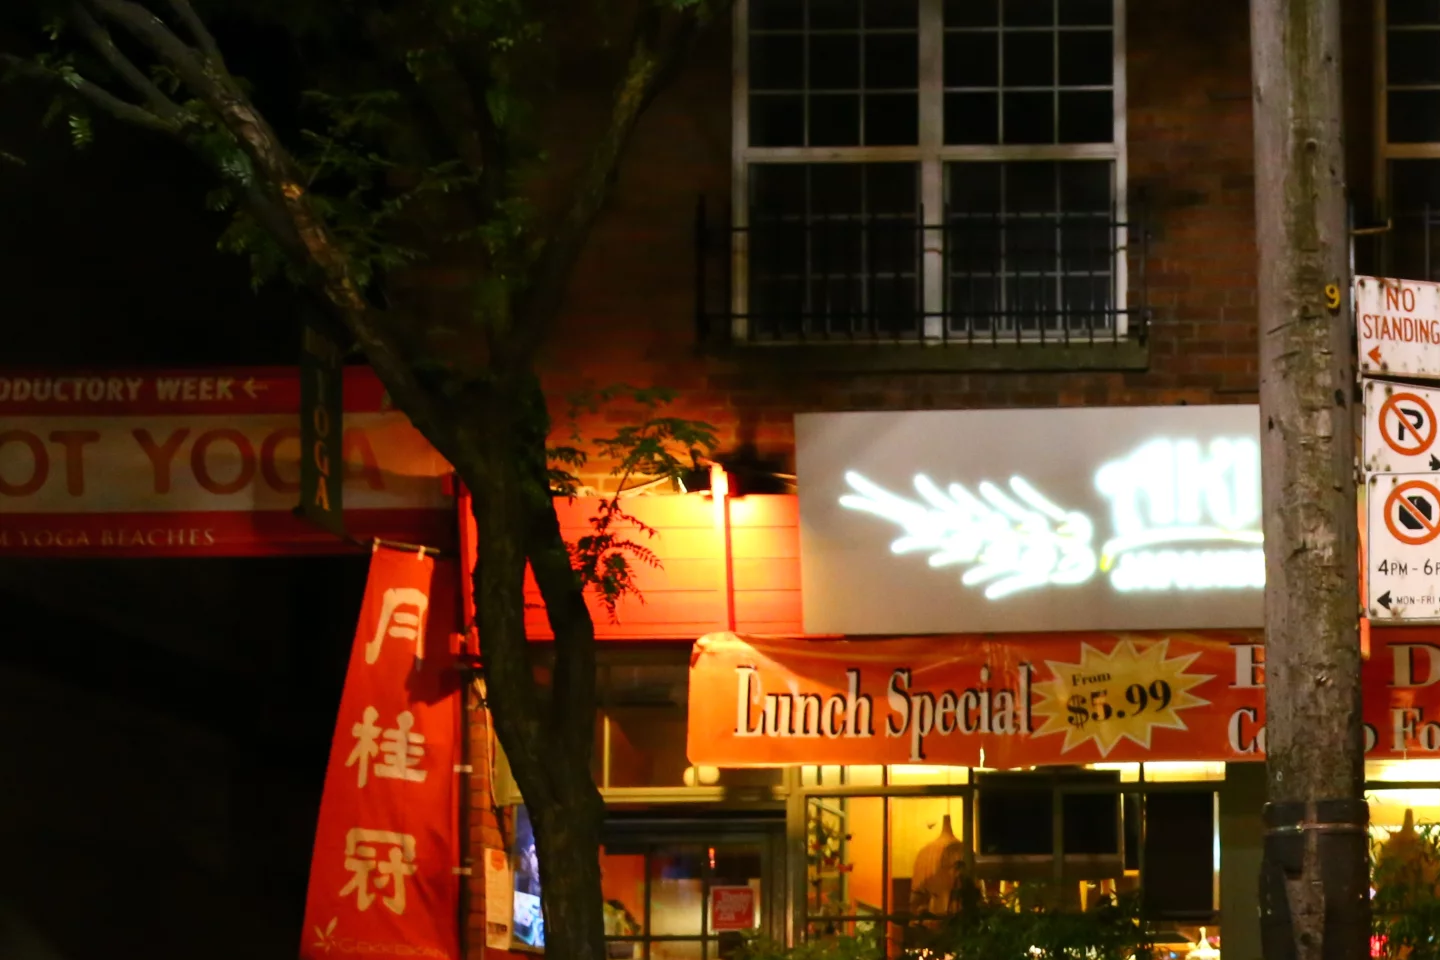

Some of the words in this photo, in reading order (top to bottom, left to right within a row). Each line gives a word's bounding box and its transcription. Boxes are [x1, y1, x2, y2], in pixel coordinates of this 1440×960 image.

[1325, 283, 1341, 308] 9
[1386, 287, 1415, 312] NO
[1363, 315, 1440, 345] STANDING
[156, 377, 235, 401] WEEK
[131, 427, 386, 496] YOGA
[19, 528, 90, 547] YOGA
[102, 527, 215, 547] BEACHES
[1378, 559, 1408, 577] 4PM
[1396, 596, 1435, 606] MON-FRI
[1071, 671, 1111, 687] From
[734, 664, 875, 739] Lunch
[886, 662, 1037, 762] Special
[1066, 678, 1172, 730] $5.99
[339, 588, 428, 914] 月桂冠
